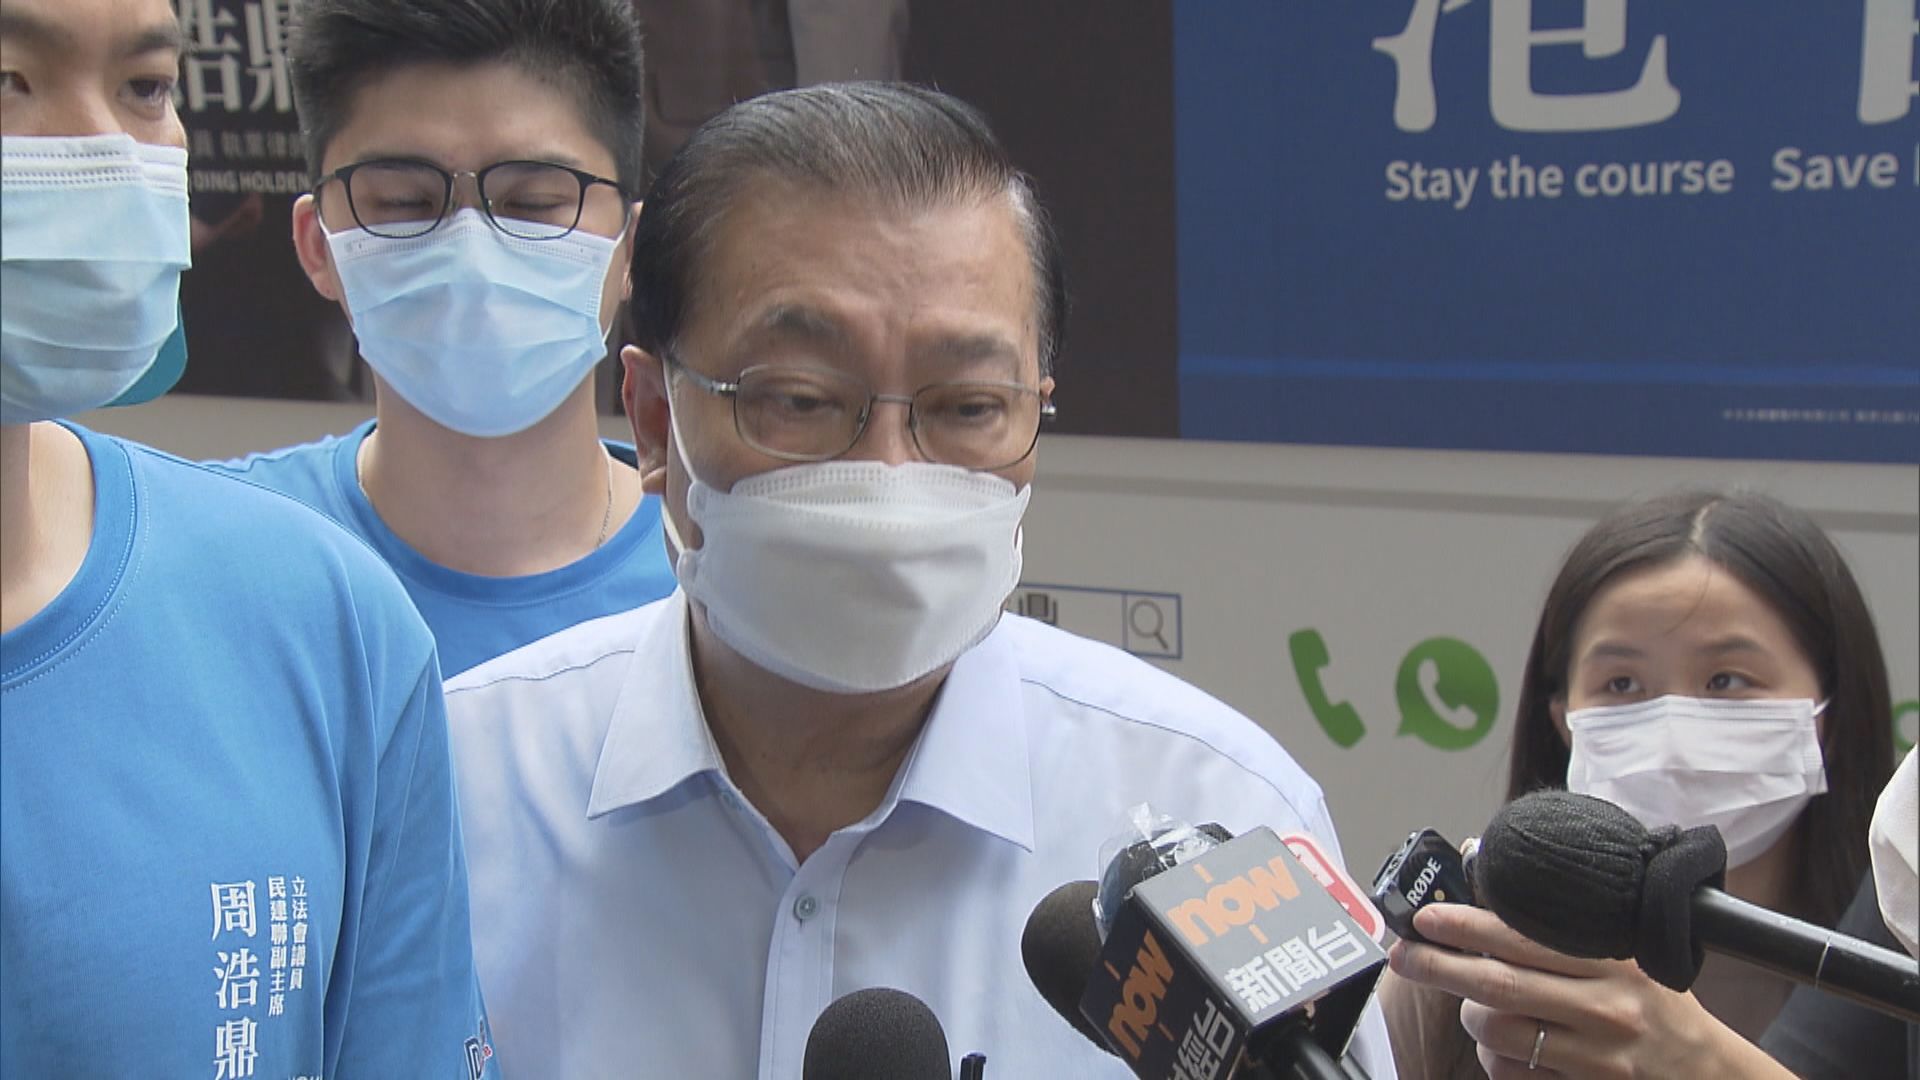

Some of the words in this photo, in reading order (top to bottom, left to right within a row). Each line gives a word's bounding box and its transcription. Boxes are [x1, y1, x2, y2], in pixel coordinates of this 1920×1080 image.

[1385, 160, 1478, 210] Stay
[1489, 155, 1564, 198] the
[1575, 158, 1735, 196] course
[1770, 147, 1898, 192] Save
[1168, 855, 1300, 947] now
[1407, 856, 1443, 907] RØDE
[210, 879, 260, 1080] 周浩鼎
[268, 875, 289, 1017] 民建聯副主席
[289, 875, 308, 991] 立法會議員
[1224, 919, 1367, 1014] 新聞台
[1108, 930, 1175, 1059] now
